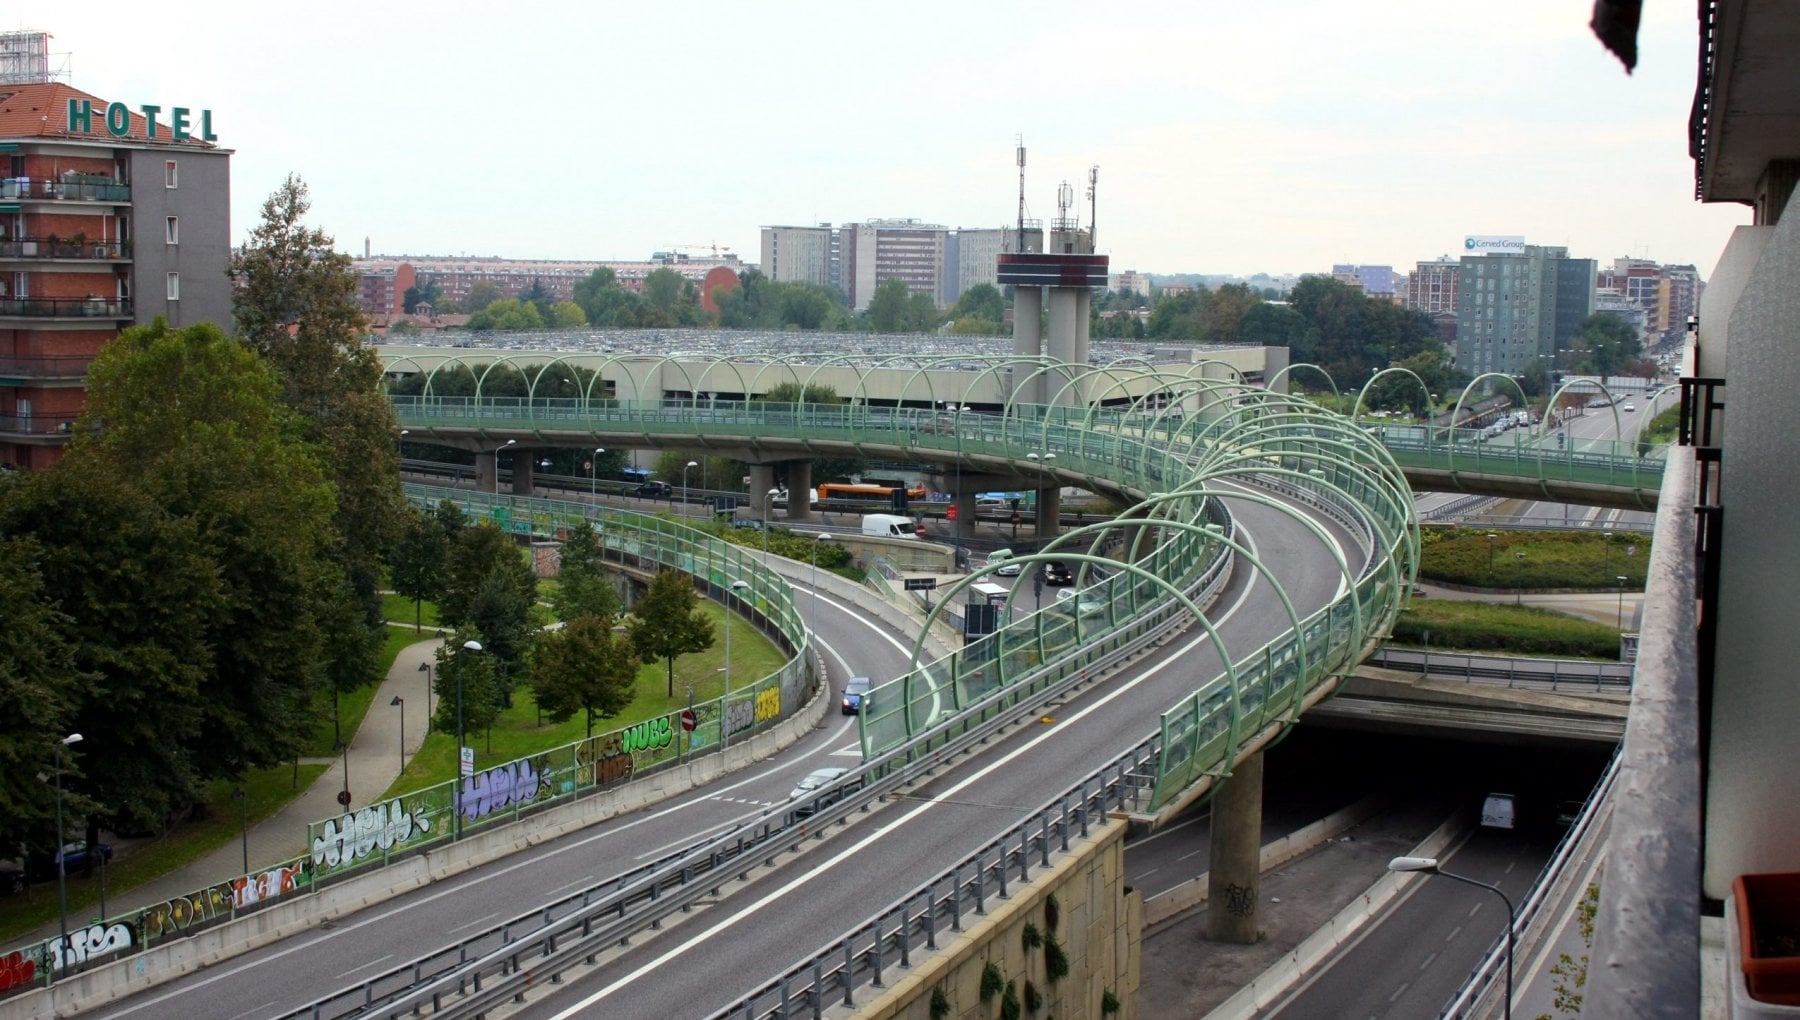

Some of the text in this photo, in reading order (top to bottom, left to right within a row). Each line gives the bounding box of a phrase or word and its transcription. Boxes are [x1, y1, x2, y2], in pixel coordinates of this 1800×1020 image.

[67, 98, 218, 142] HOTEL
[1476, 240, 1525, 250] Cerved Group
